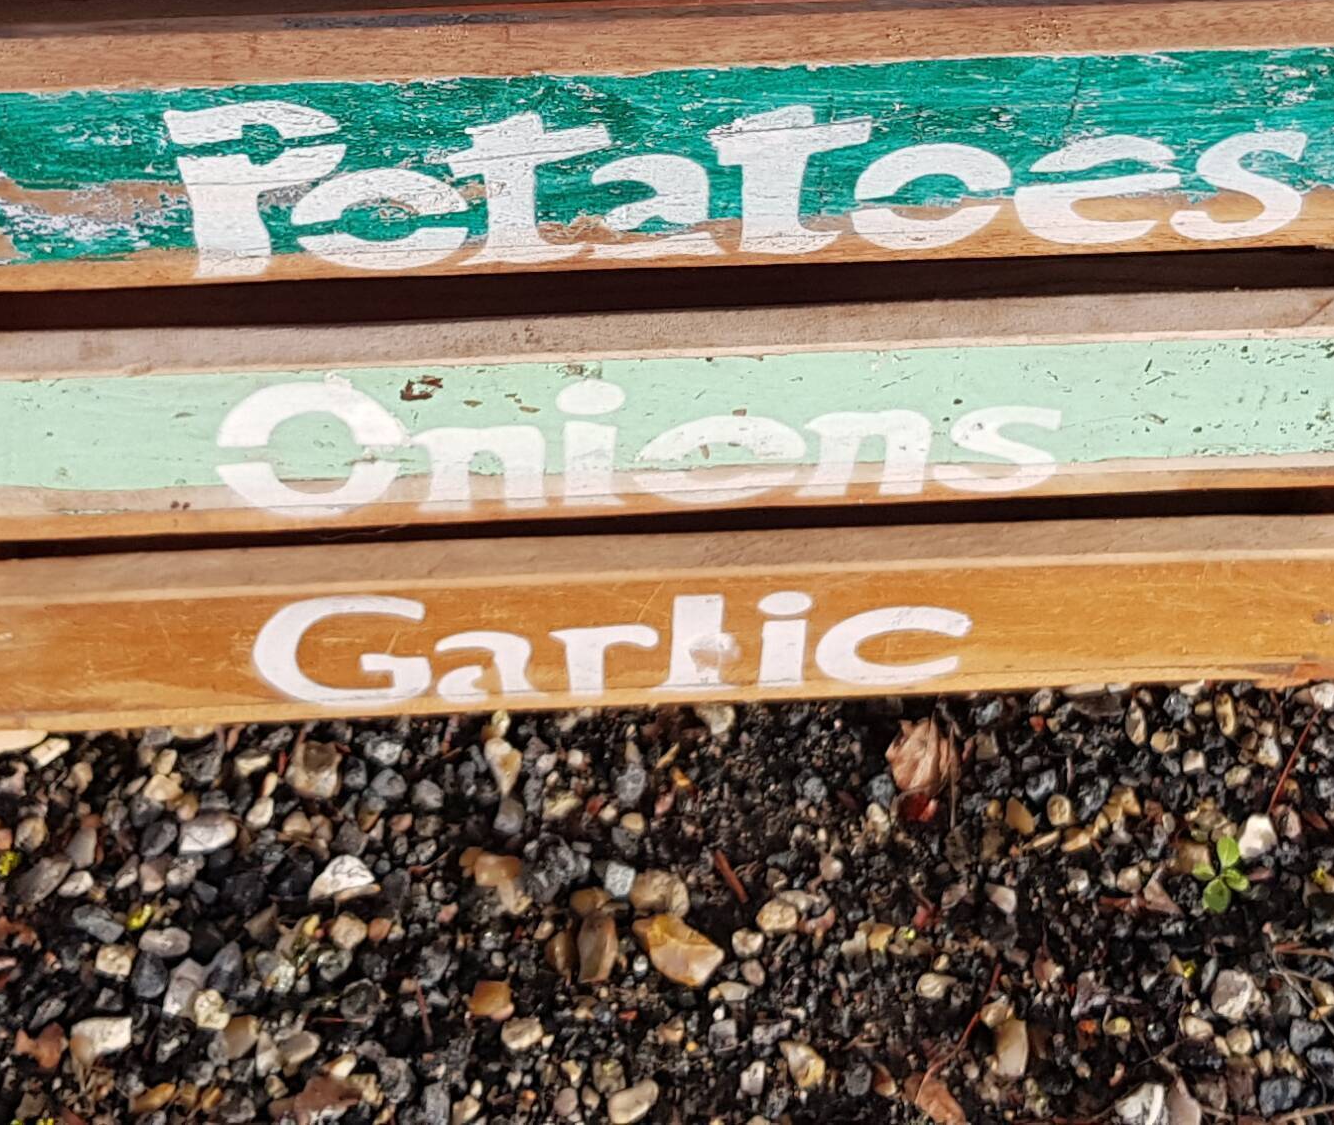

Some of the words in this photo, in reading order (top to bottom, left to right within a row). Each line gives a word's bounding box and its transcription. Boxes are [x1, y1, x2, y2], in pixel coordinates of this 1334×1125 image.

[164, 100, 1306, 279] Potatoes
[216, 378, 1062, 517] Onions
[252, 591, 971, 706] Garlic
